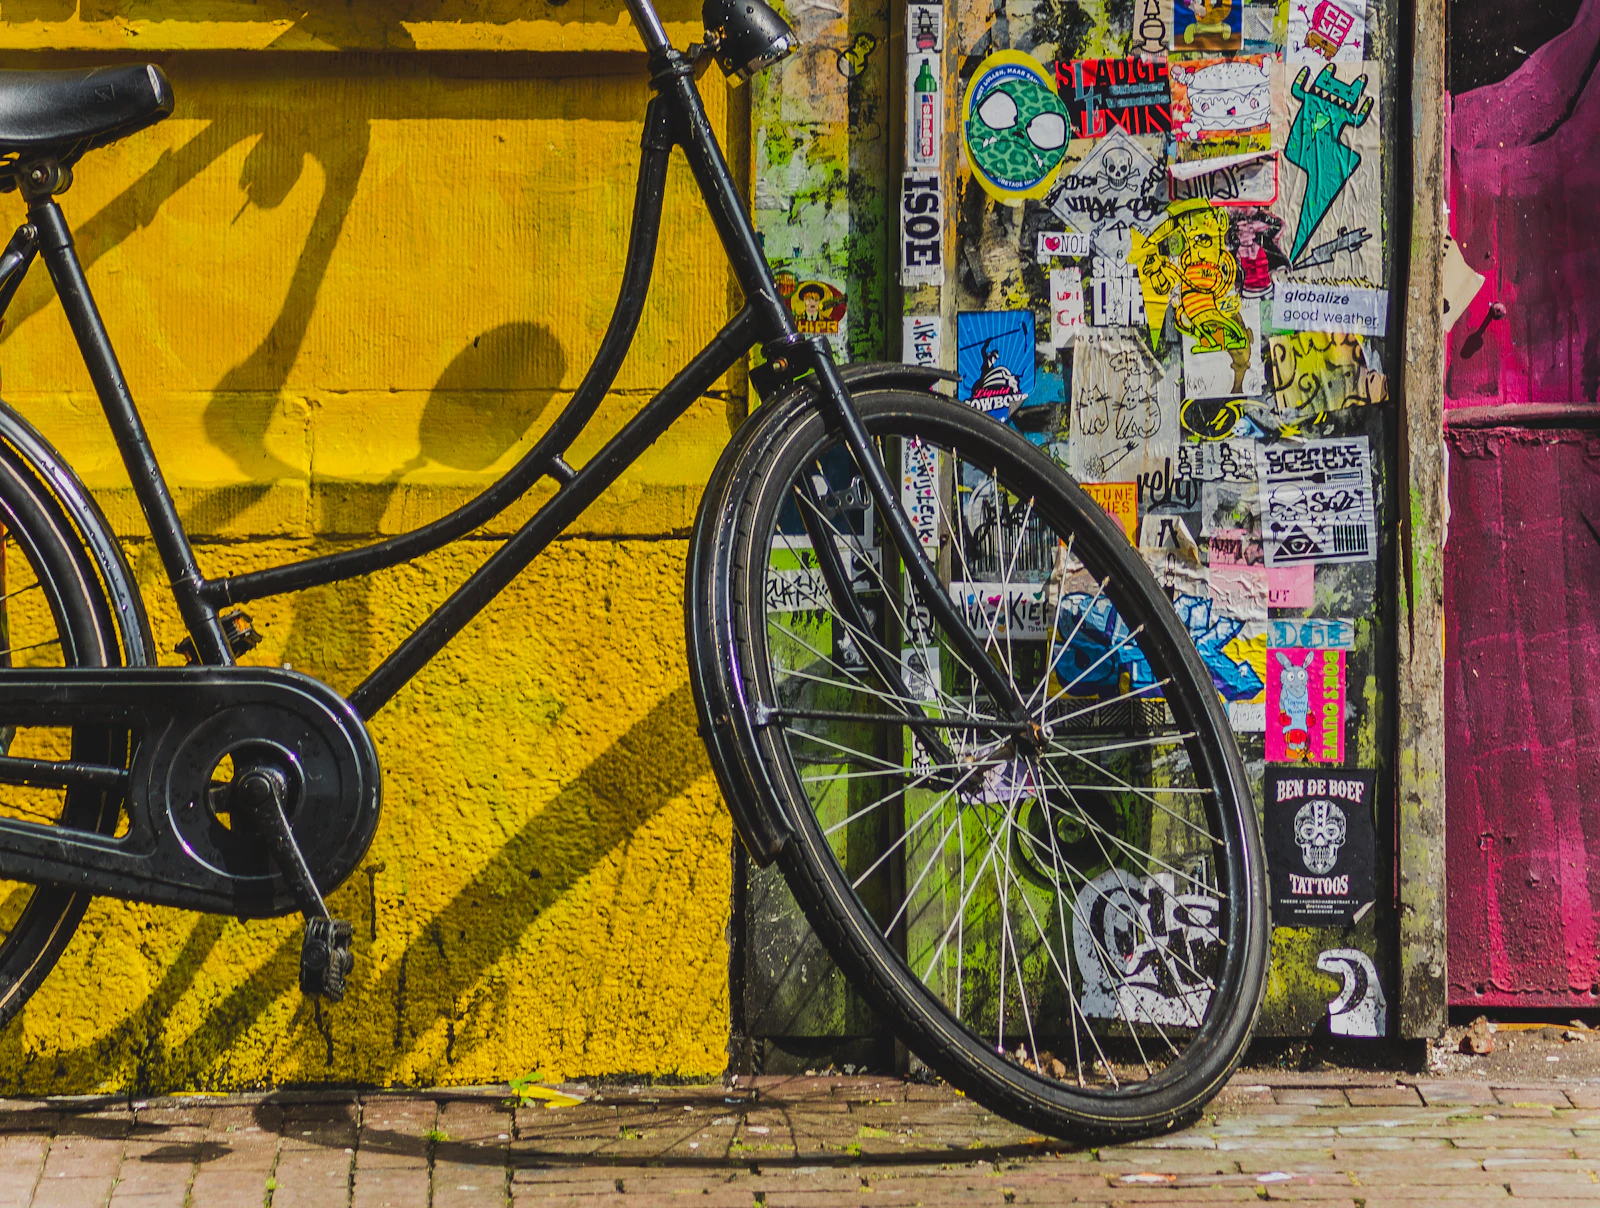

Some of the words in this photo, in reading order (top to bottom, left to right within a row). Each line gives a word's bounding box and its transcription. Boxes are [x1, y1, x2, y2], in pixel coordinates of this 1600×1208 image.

[1108, 81, 1166, 96] Sticker
[1105, 94, 1171, 109] Vandals
[904, 176, 941, 267] ISOE
[1040, 234, 1047, 252] I
[1060, 235, 1088, 254] NOL
[1116, 249, 1124, 260] 6
[1284, 289, 1350, 306] globalize
[1283, 308, 1319, 323] good
[1323, 311, 1380, 327] weather.
[973, 386, 1011, 399] Liquid
[915, 494, 935, 540] LEUK
[1323, 650, 1340, 700] BOKS
[1322, 706, 1339, 760] OUWE
[1276, 778, 1305, 803] BEN
[1307, 778, 1328, 796] DE
[1328, 779, 1365, 804] BOEF
[1289, 873, 1350, 896] TATTOOS
